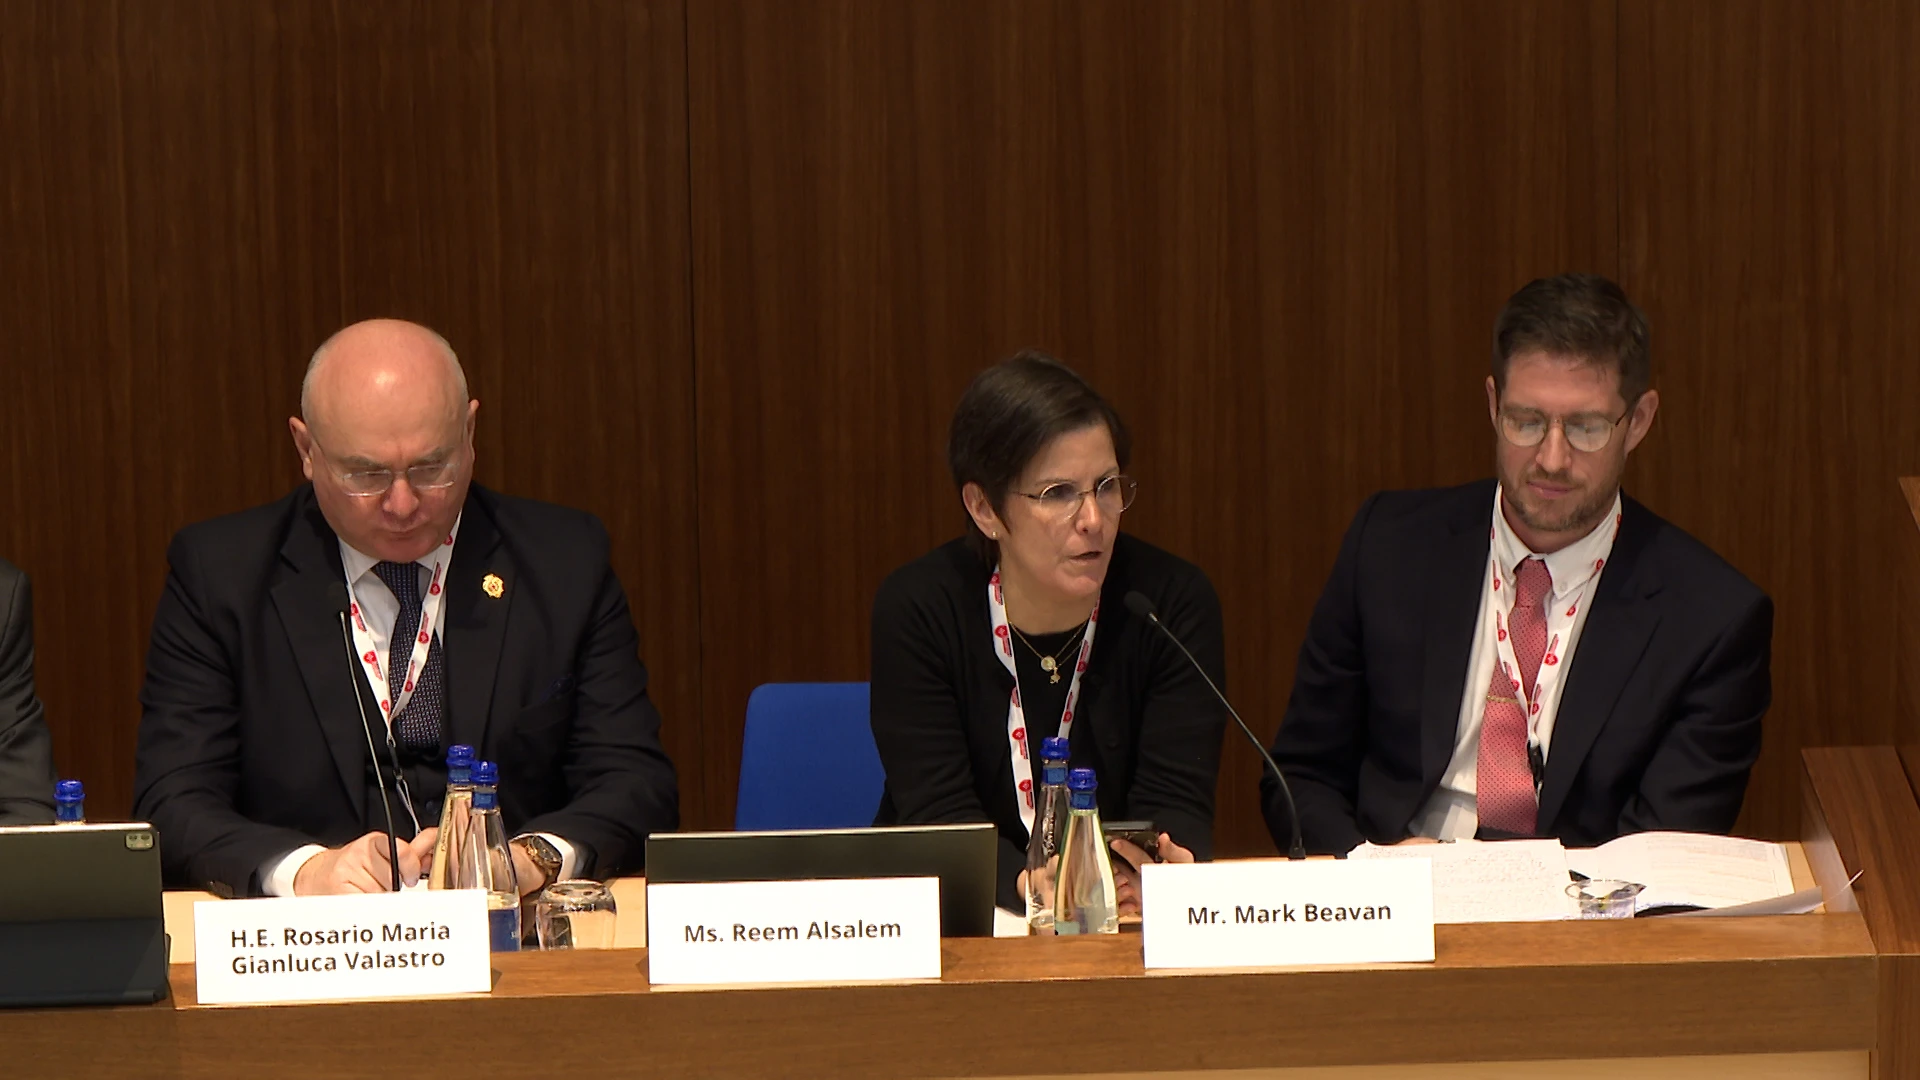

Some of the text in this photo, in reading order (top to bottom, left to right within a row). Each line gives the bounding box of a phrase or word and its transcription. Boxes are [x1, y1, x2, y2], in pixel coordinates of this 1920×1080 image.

[1188, 903, 1392, 925] Mr. Mark Beavan
[231, 921, 451, 948] H.E. Rosario Maria
[685, 919, 902, 943] Ms. Reem Alsalem
[232, 948, 446, 976] Gianluca Valastro
